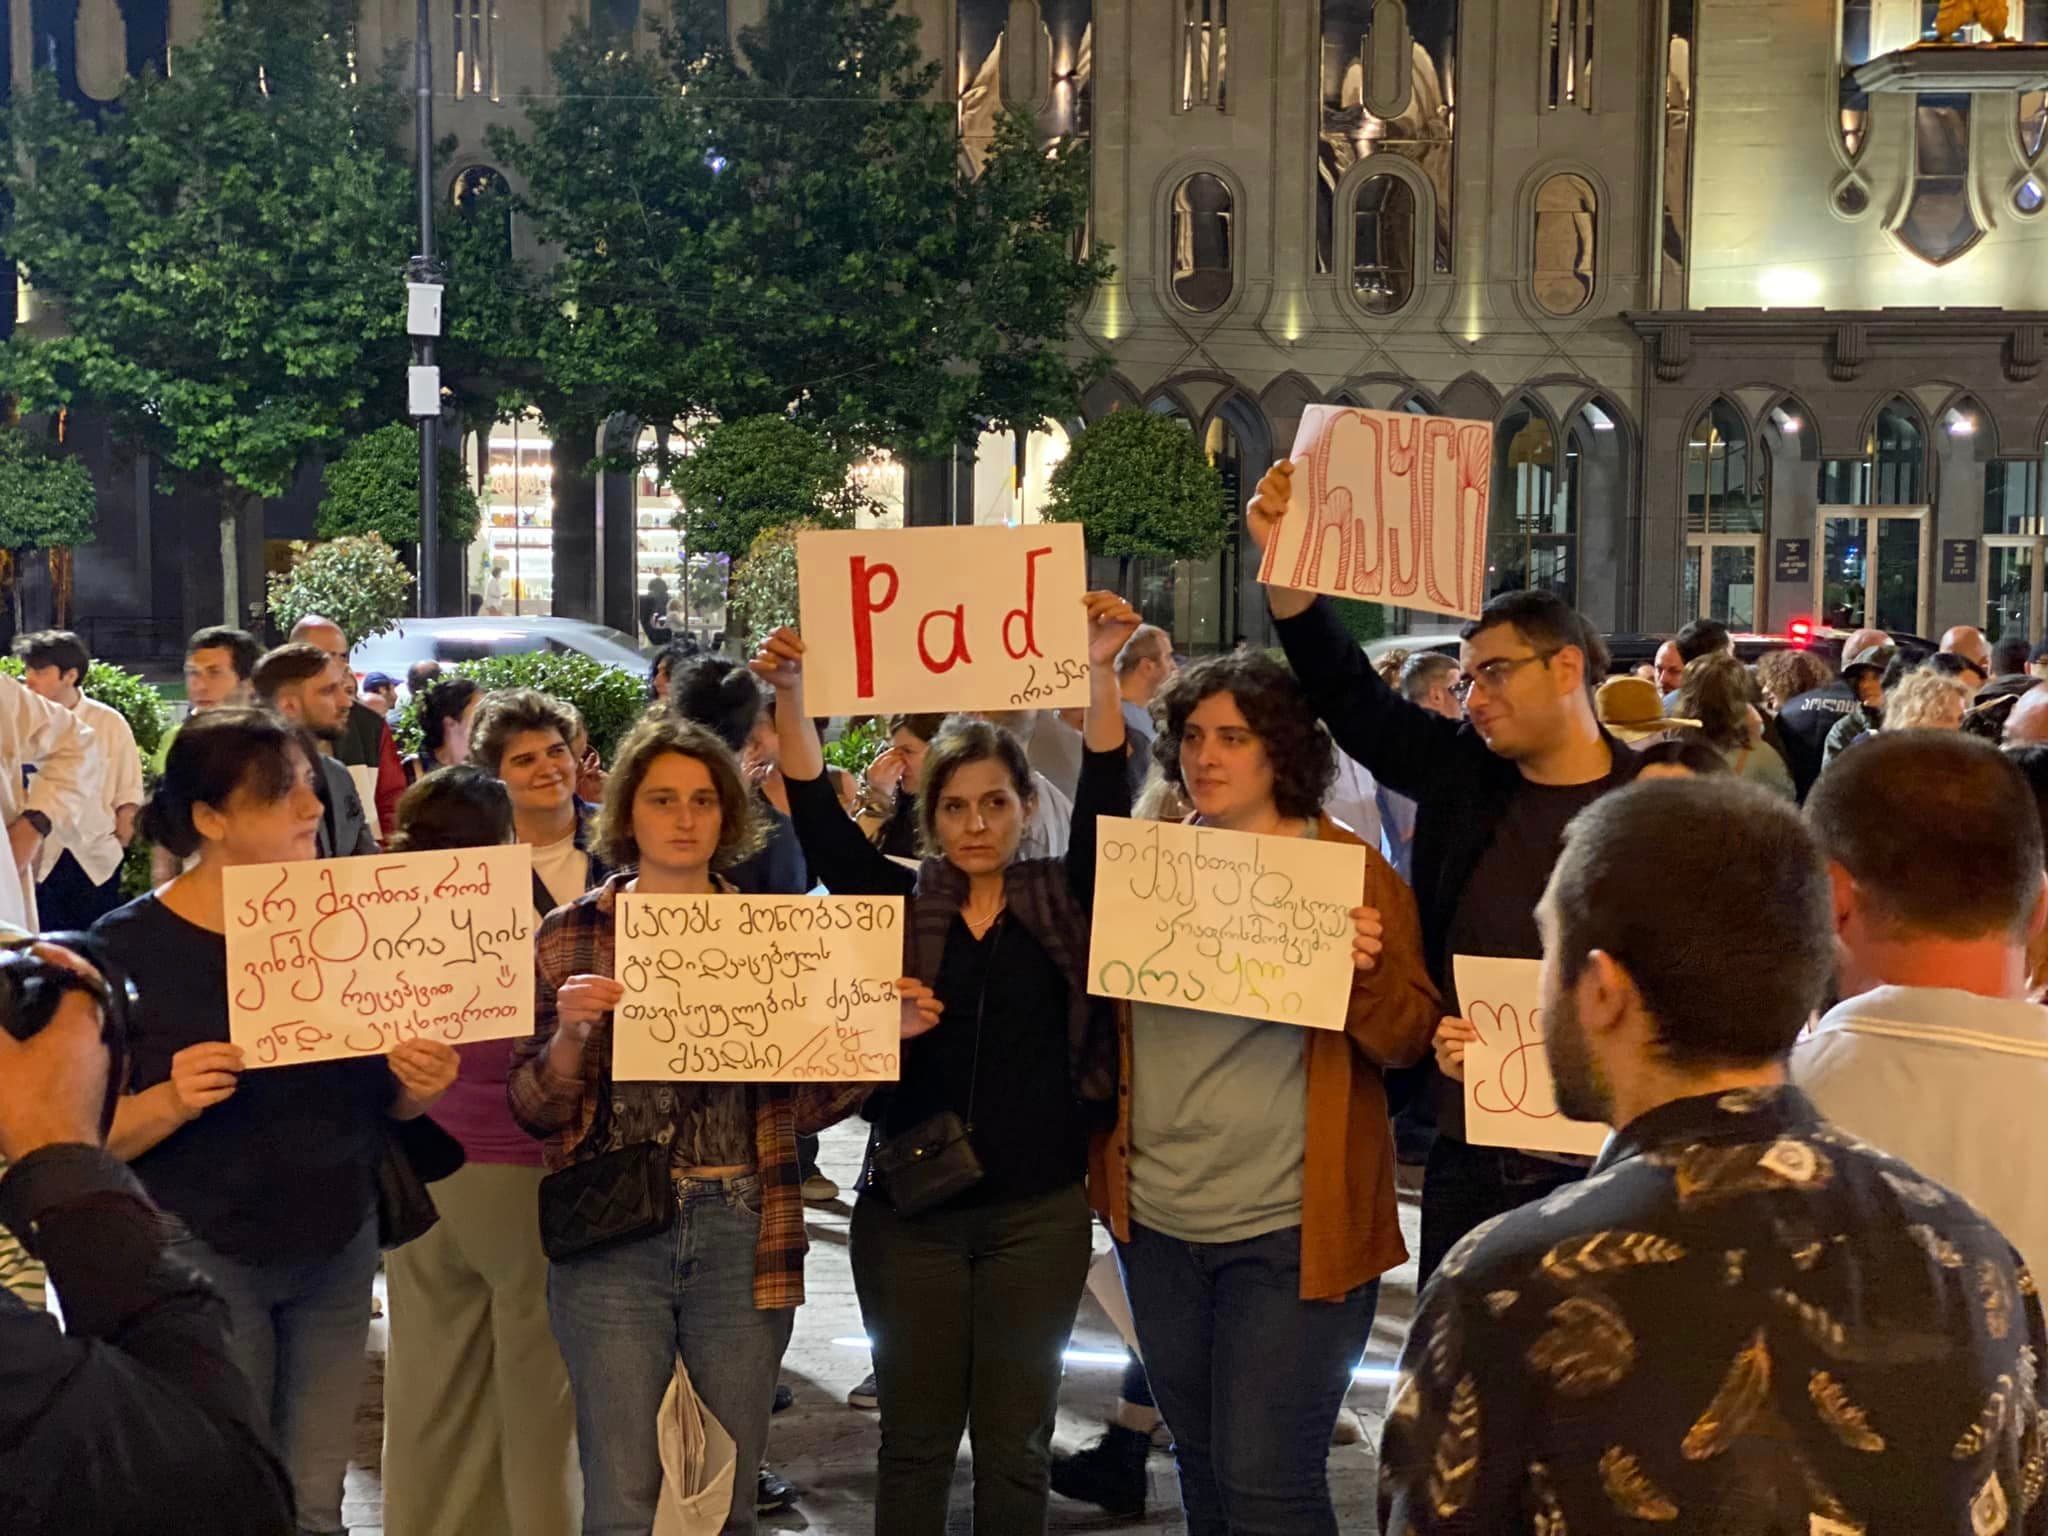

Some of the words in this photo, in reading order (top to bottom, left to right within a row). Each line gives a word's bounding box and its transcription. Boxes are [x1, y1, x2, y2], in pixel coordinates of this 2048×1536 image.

[1801, 697, 1857, 714] პოლიც
[237, 867, 297, 927] არ
[433, 856, 491, 898] რომ
[738, 900, 896, 935] მონობაში
